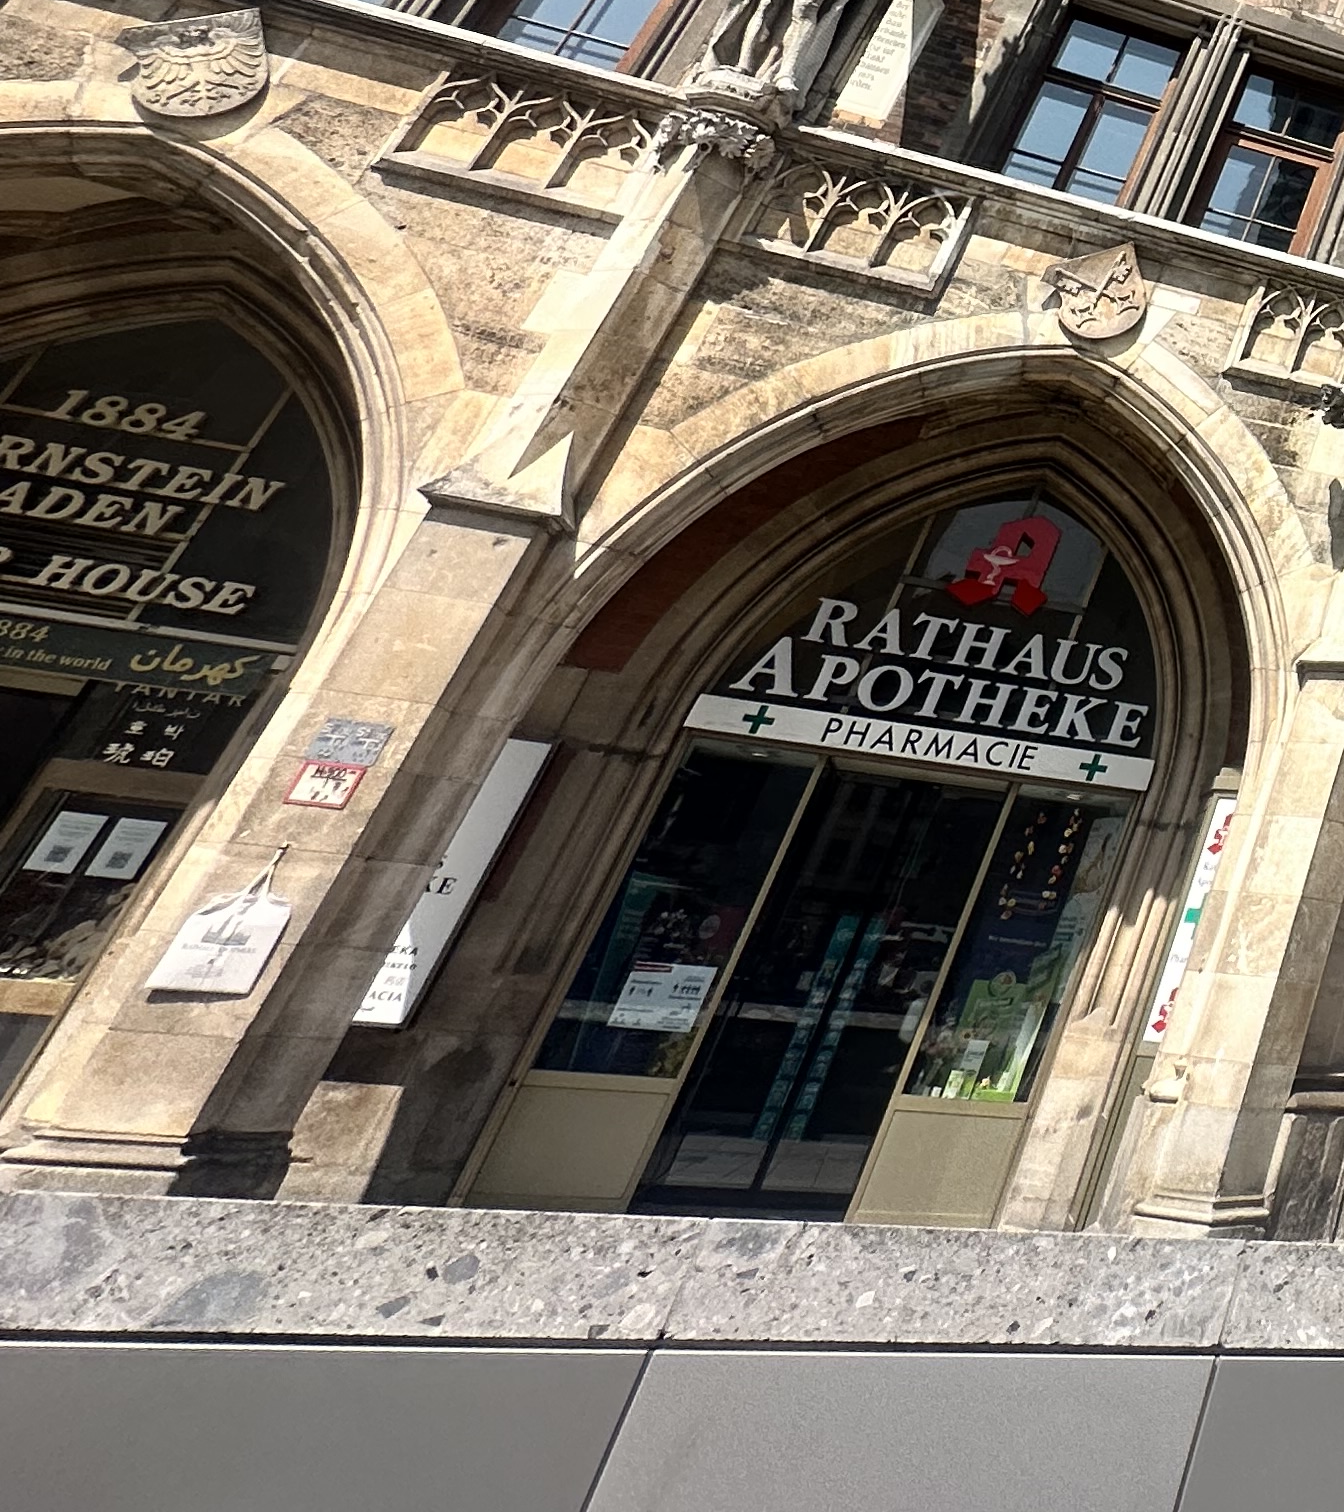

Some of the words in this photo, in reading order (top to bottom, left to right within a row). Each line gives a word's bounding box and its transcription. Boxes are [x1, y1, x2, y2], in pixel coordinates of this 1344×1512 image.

[46, 390, 206, 440] 1884
[28, 555, 256, 615] HOUSE
[2, 646, 24, 659] in
[26, 649, 57, 663] the
[59, 654, 113, 671] world
[800, 597, 1129, 691] RATHAUS
[729, 636, 1149, 749] APOTHEKE
[820, 718, 1039, 771] PHARMACIE
